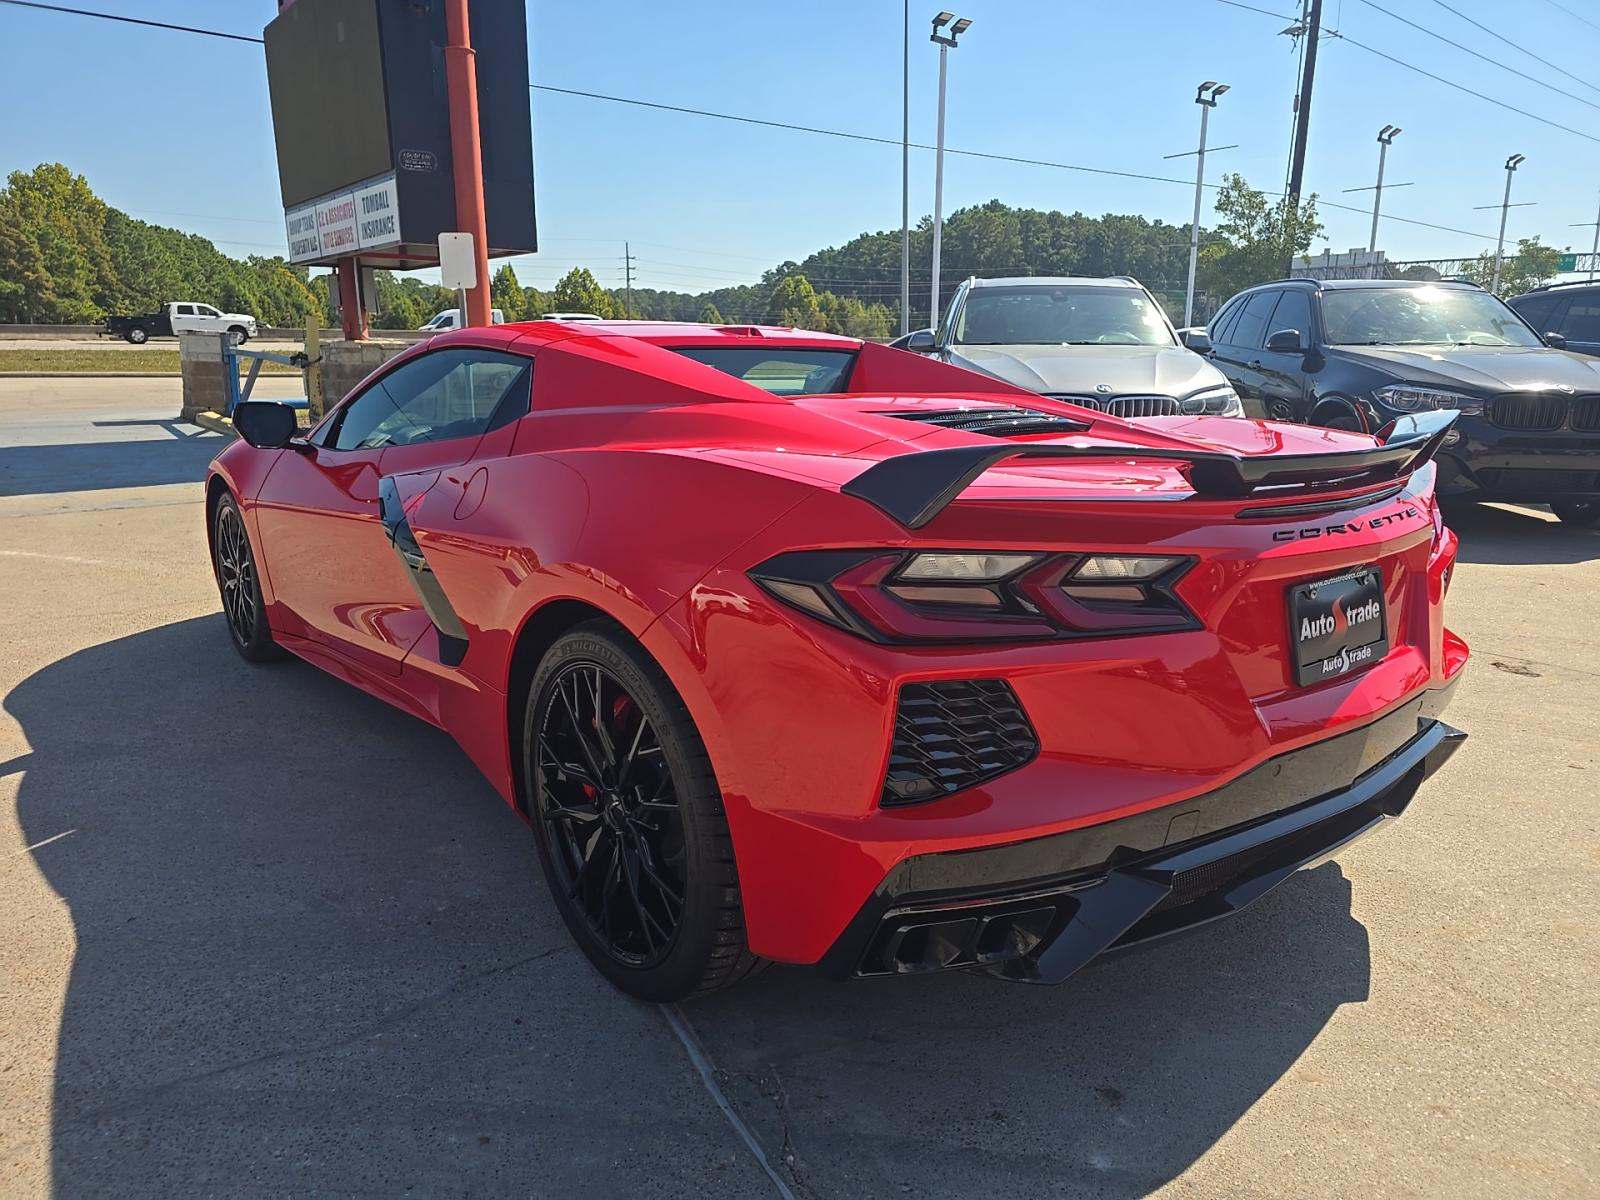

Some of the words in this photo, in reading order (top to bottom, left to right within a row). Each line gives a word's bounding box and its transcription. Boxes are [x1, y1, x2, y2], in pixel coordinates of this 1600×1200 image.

[362, 190, 389, 214] TOMBALL
[362, 215, 395, 240] INSURANCE
[1272, 507, 1418, 542] CORVETTE
[572, 640, 618, 664] MICHELIN
